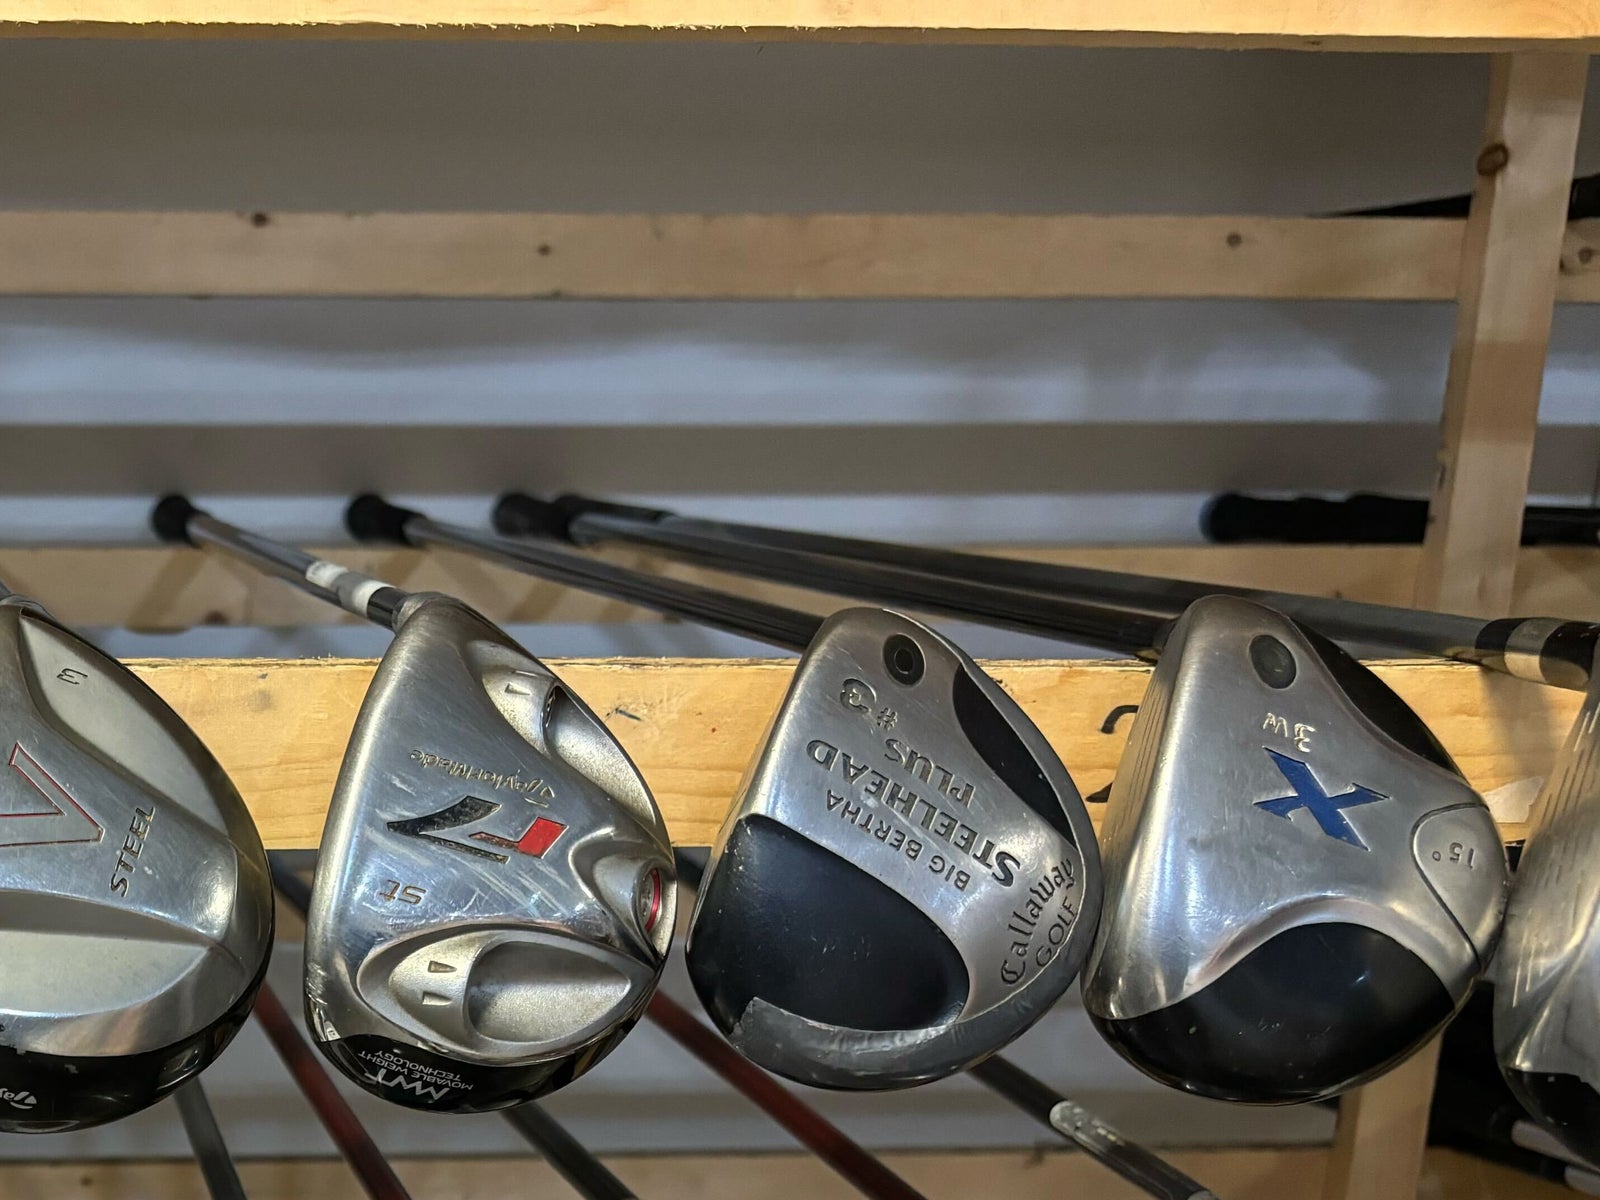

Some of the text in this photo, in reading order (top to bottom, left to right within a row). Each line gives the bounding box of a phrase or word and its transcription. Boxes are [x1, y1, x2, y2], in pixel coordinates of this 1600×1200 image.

[410, 749, 556, 808] TaylorMade
[884, 738, 977, 808] PLUS
[805, 739, 1022, 888] STEELHEAD
[825, 788, 972, 893] BIG BERTHA
[109, 806, 157, 898] STEEL
[1001, 858, 1076, 985] Callaway
[1035, 895, 1079, 968] GOLF
[357, 1049, 475, 1091] MOVABLE WEIGHT
[374, 1049, 462, 1082] TECHNOLOGY
